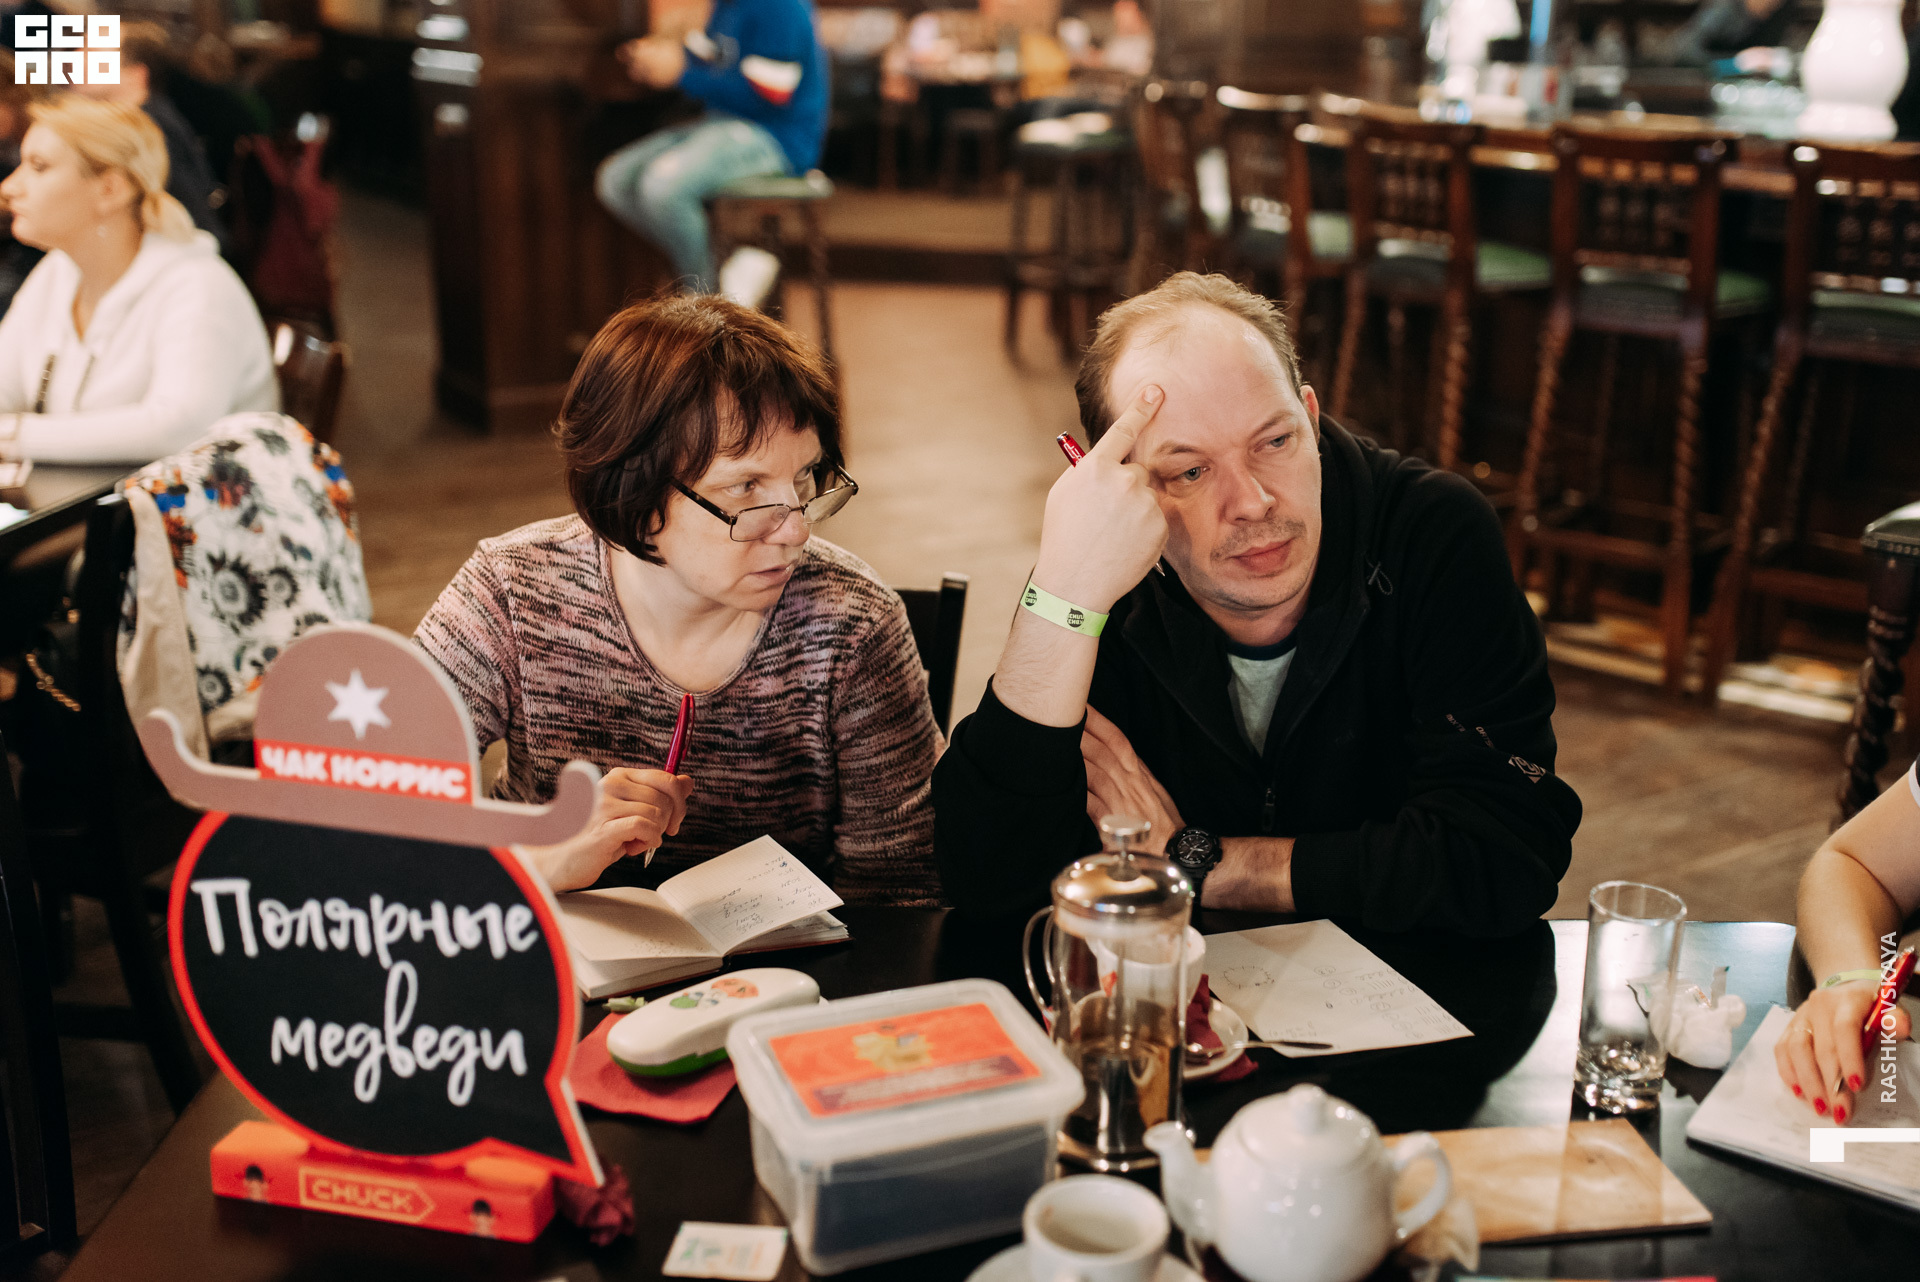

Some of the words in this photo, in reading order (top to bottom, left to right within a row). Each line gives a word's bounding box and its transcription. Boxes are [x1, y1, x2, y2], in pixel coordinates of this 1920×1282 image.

[261, 746, 328, 781] ЧАК
[330, 754, 466, 798] НОРРИС
[190, 878, 539, 970] Полярные
[270, 960, 528, 1107] медведи
[312, 1178, 413, 1213] CHUCK
